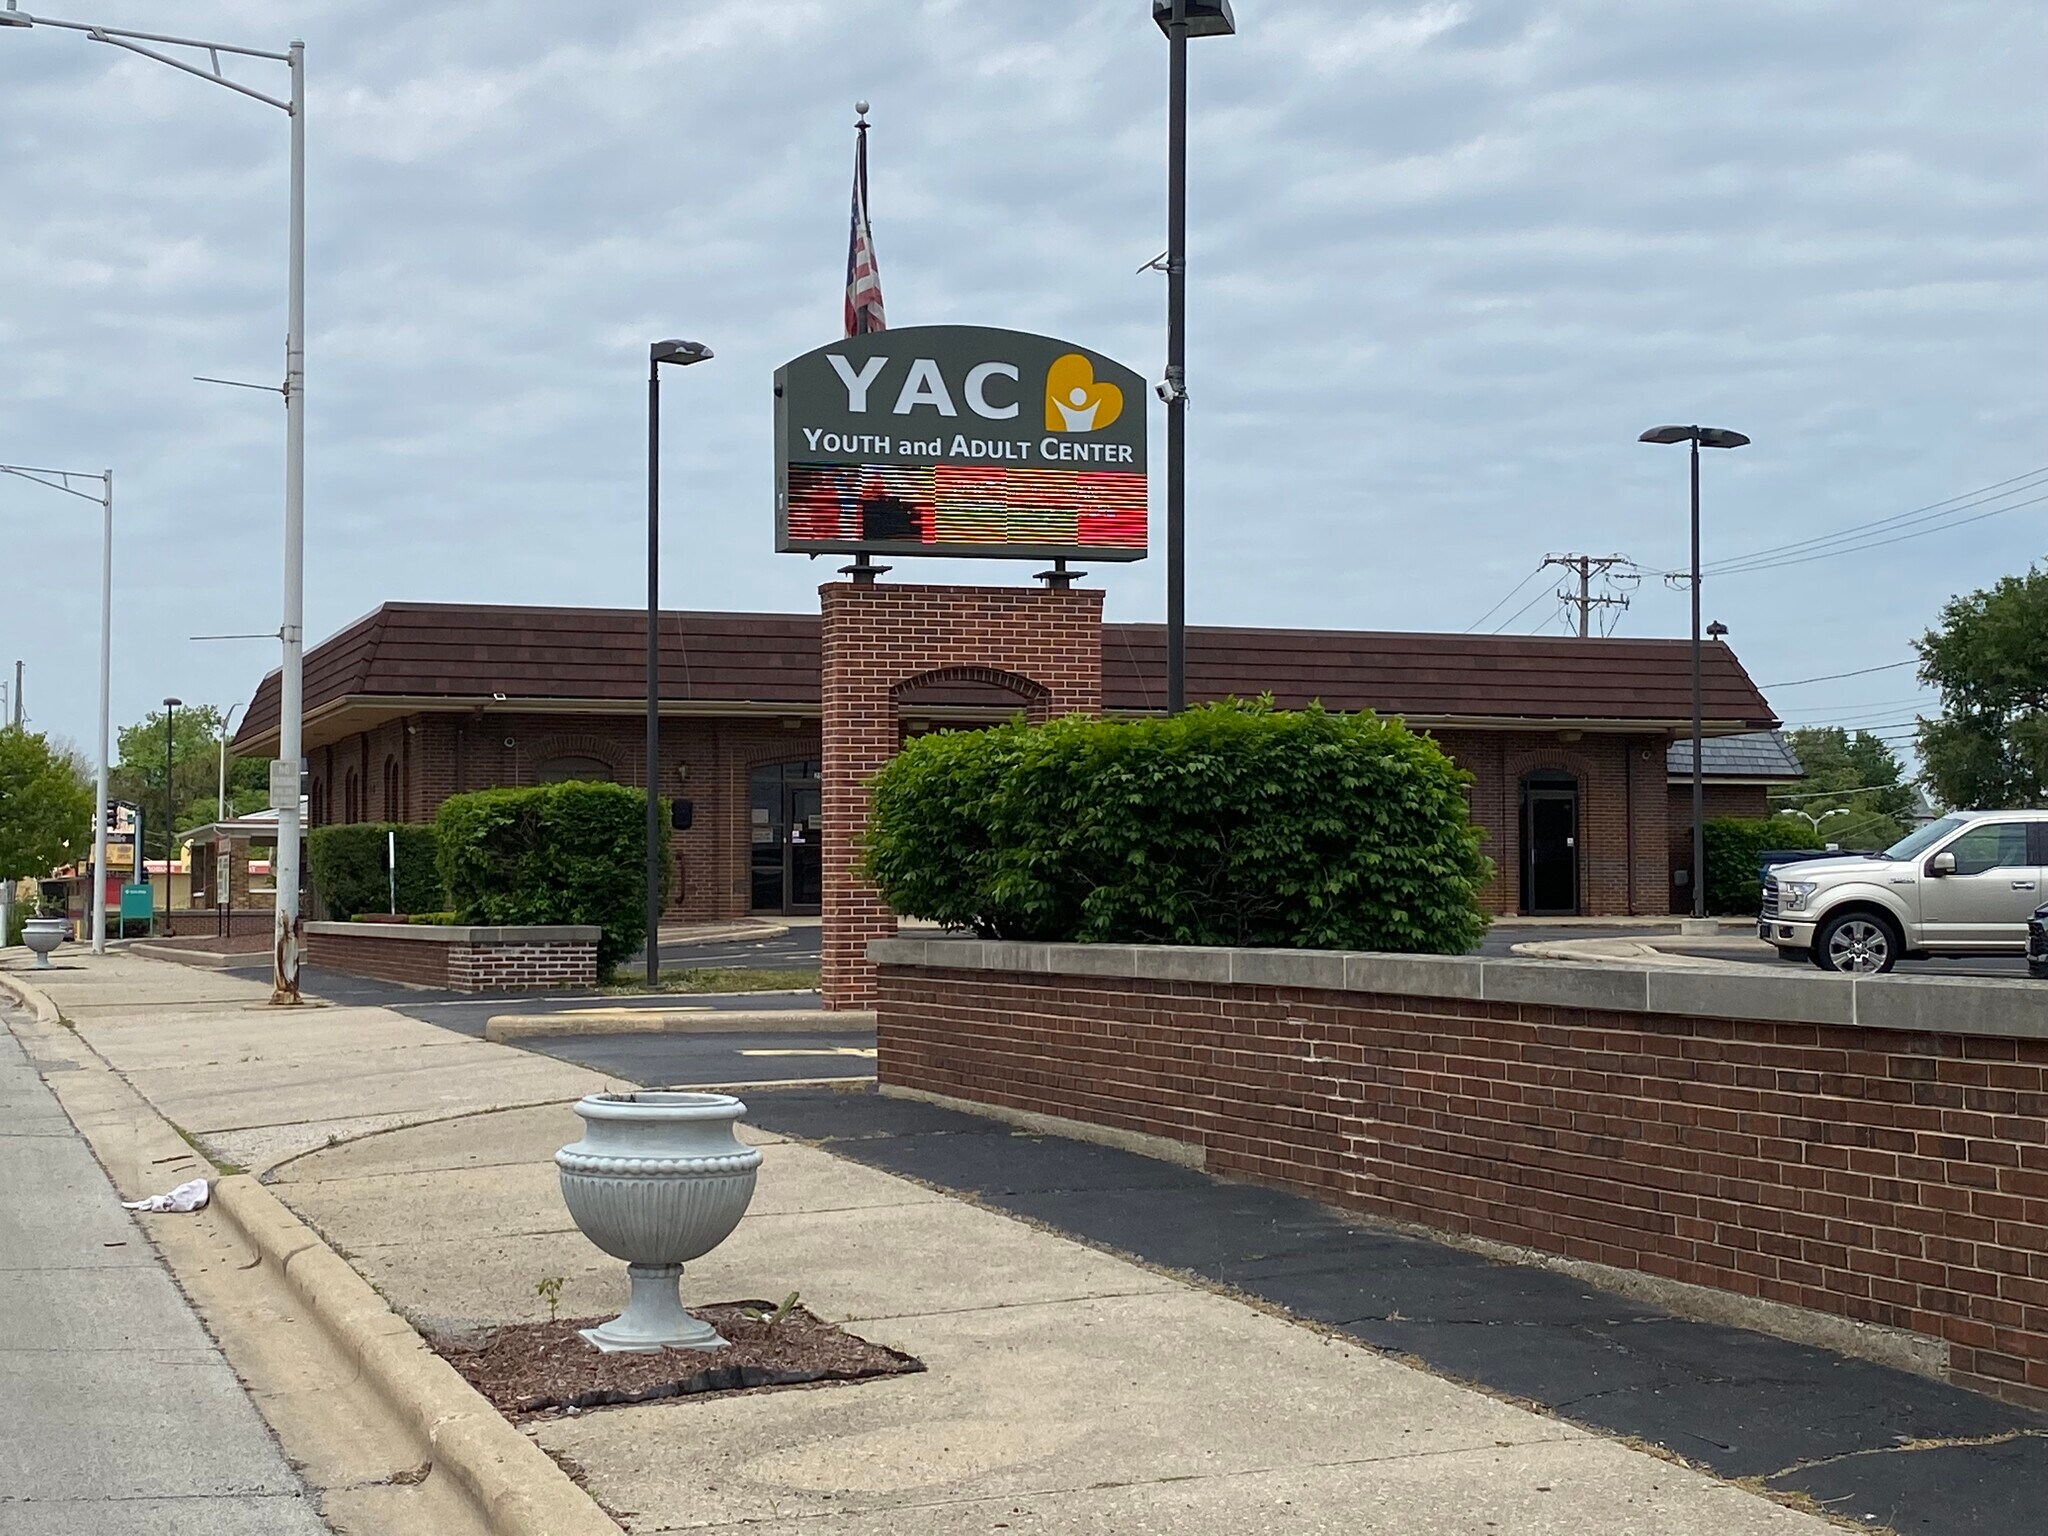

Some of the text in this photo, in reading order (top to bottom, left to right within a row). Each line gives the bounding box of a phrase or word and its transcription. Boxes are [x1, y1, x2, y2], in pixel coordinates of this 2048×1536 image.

[826, 354, 1019, 420] YAC
[802, 428, 1134, 463] YOUTH and ADULT CENTER
